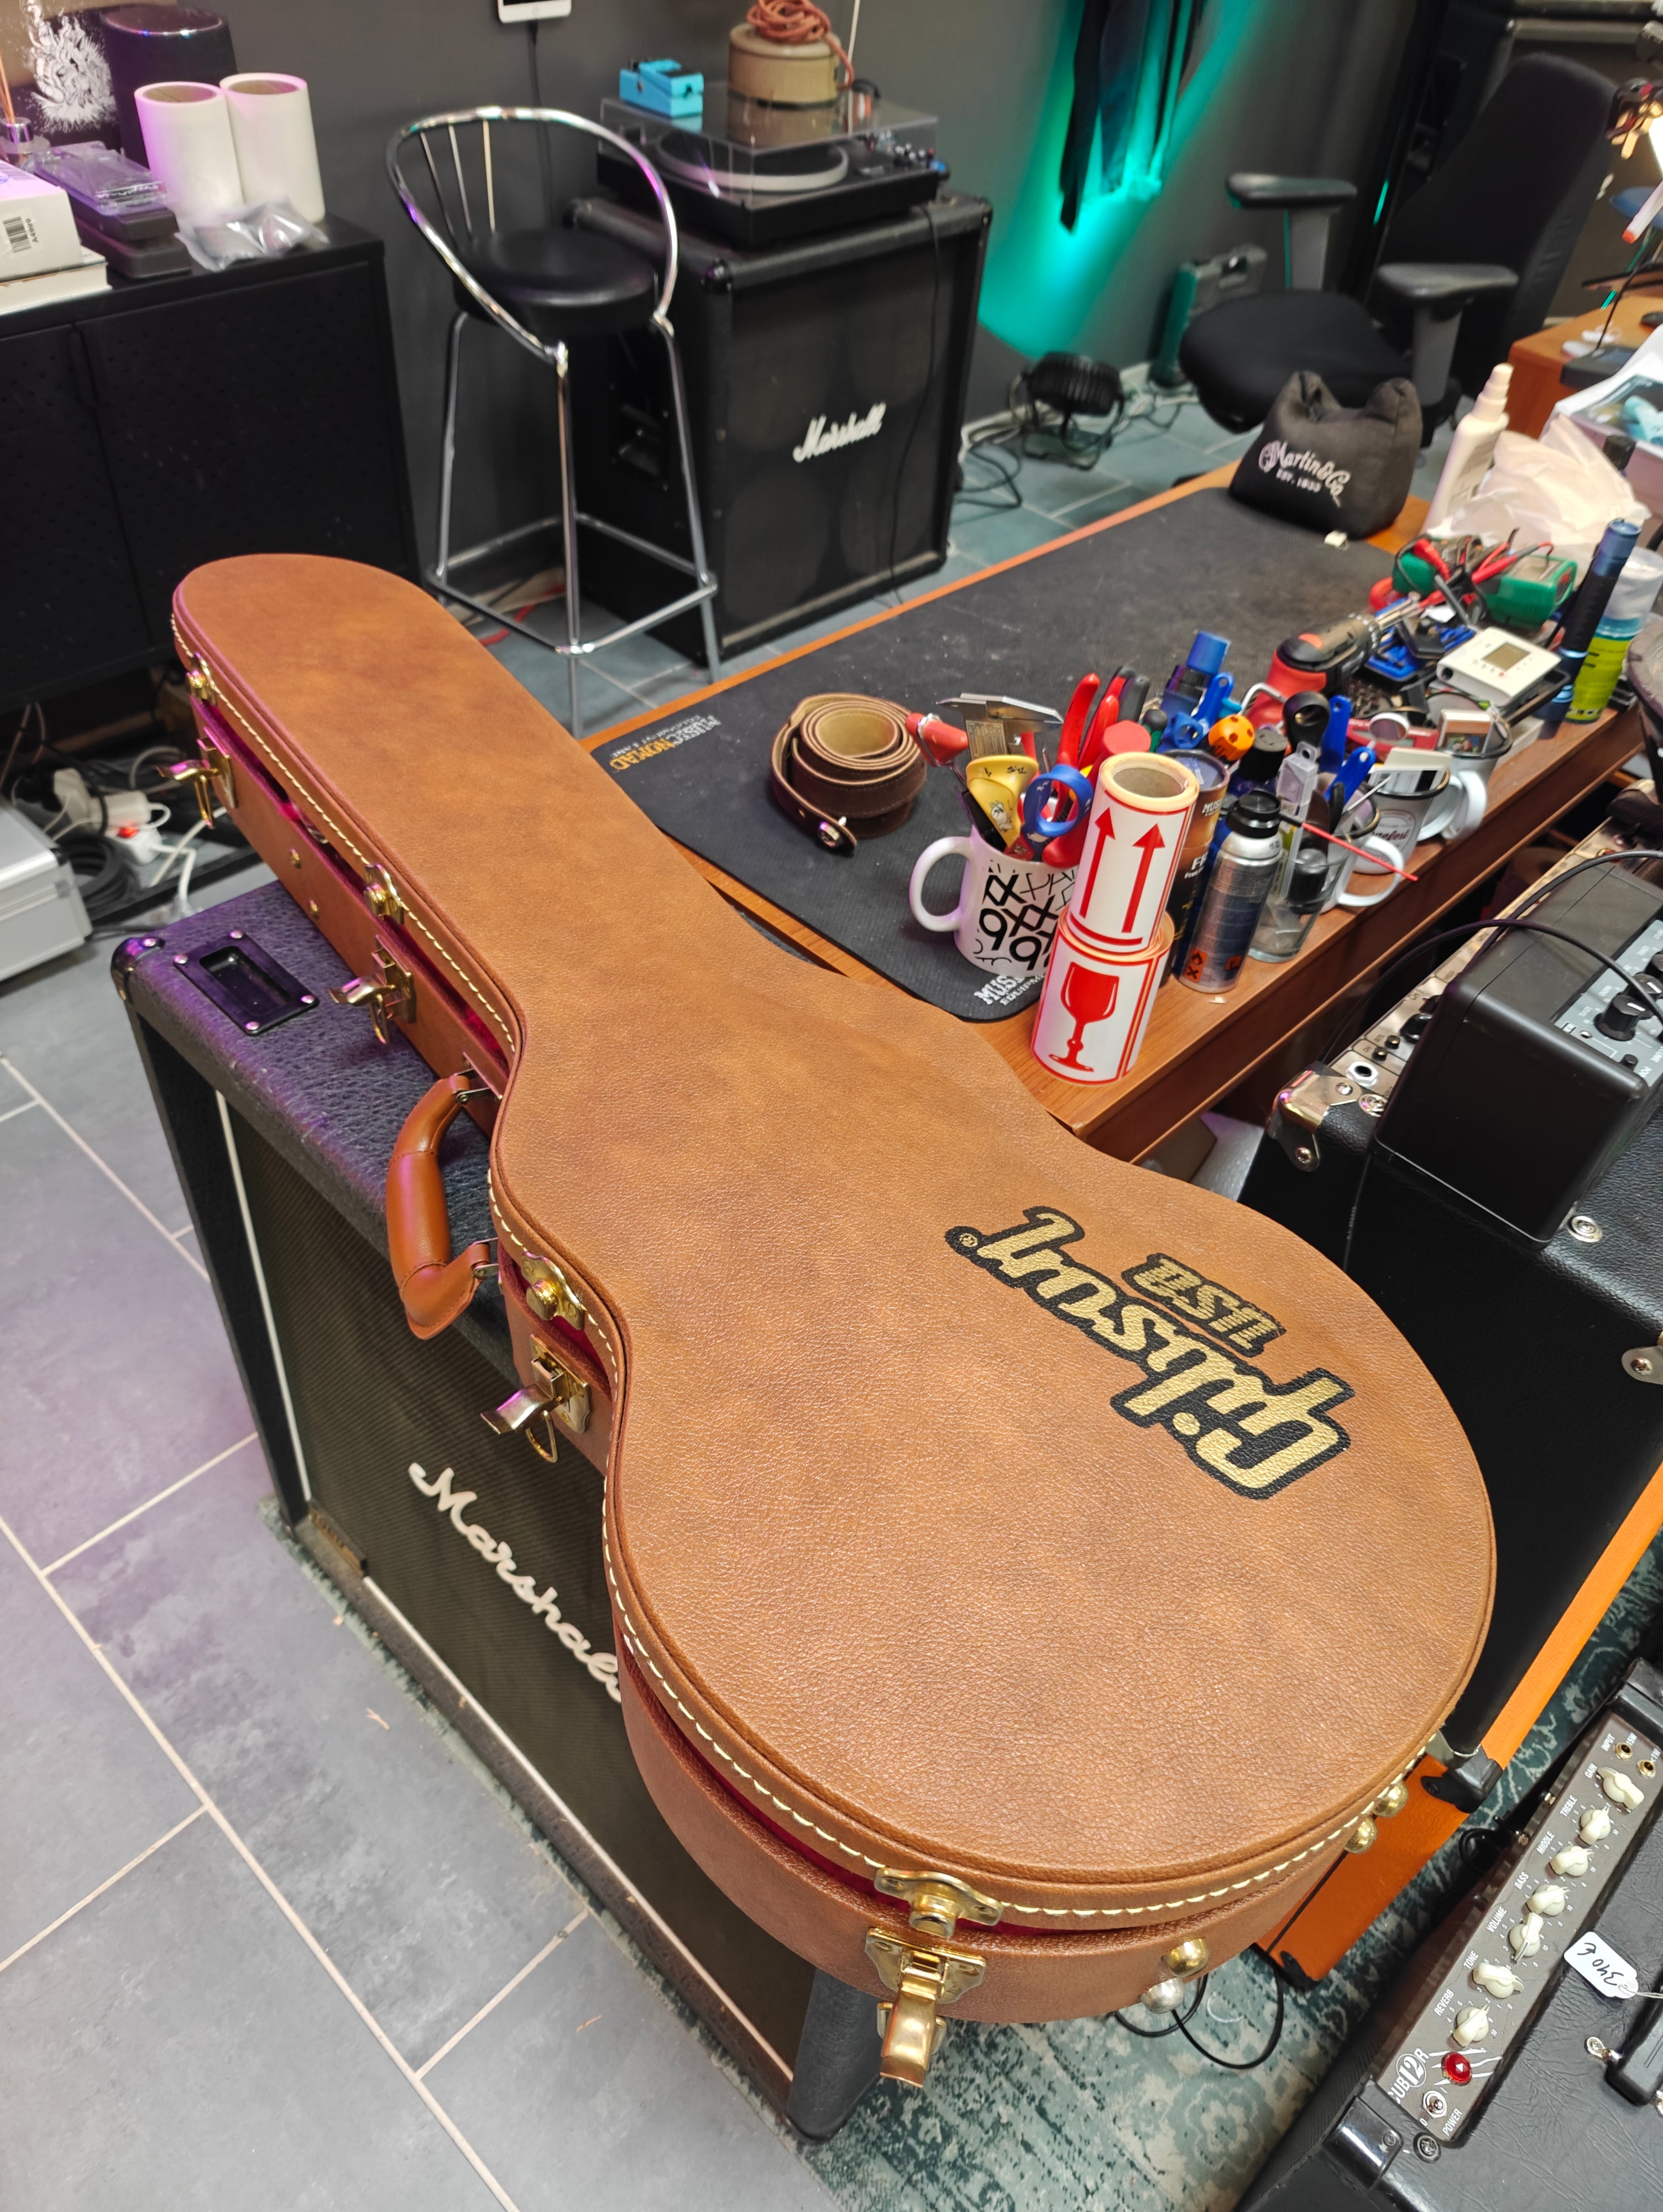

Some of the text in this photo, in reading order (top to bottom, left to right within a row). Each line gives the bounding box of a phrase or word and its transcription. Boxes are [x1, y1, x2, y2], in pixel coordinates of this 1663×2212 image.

[793, 400, 886, 463] Marshall
[948, 1206, 1355, 1499] Gibson
[1601, 1733, 1615, 1752] INPUT
[1584, 1763, 1597, 1778] GAIN
[1560, 1794, 1577, 1817] TREBLE
[1536, 1830, 1555, 1855] MIDDLE
[1514, 1871, 1529, 1890] BASS
[1486, 1906, 1507, 1933] VOLUME
[1463, 1950, 1479, 1969] TONE
[1434, 1989, 1455, 2016] REVERB
[1442, 2108, 1463, 2136] POWER
